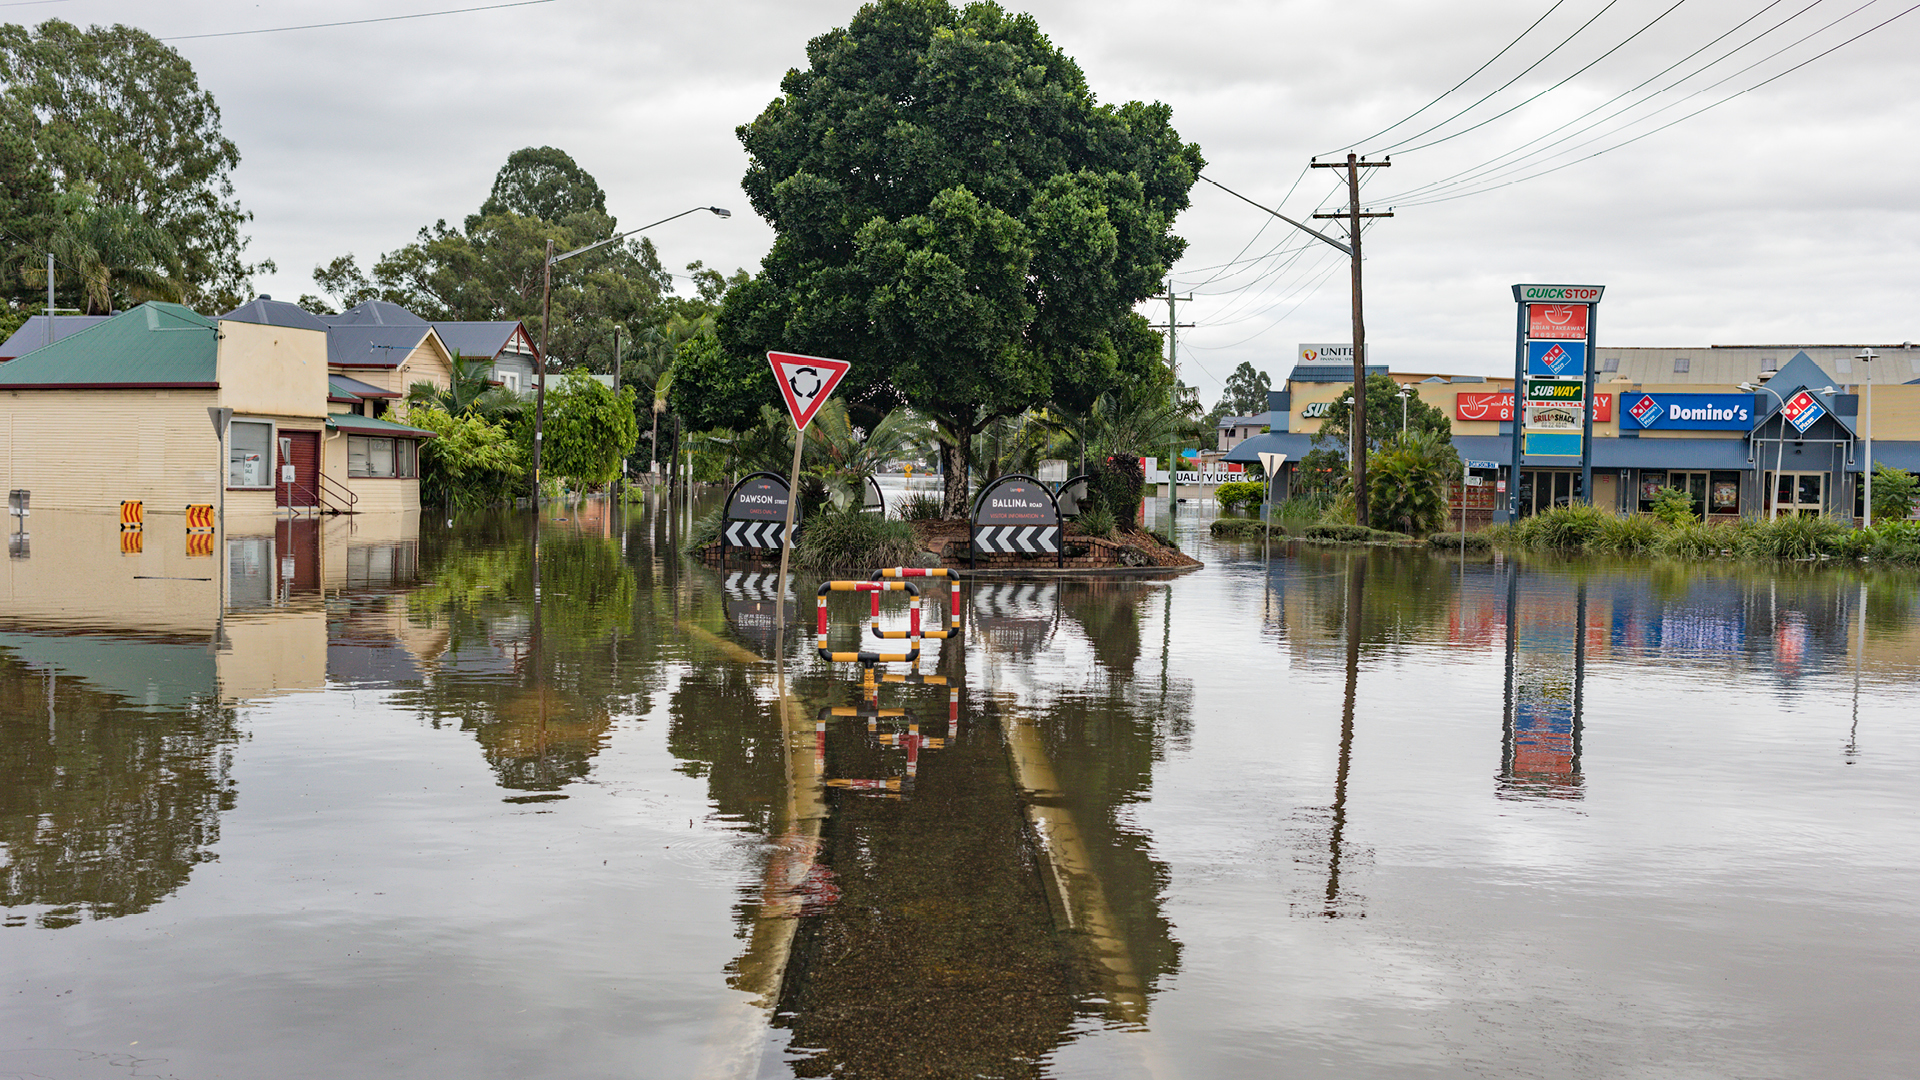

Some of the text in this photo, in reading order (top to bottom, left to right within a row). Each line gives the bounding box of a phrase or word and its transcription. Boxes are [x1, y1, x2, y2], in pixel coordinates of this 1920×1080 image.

[1320, 347, 1354, 356] UNITE
[1530, 385, 1581, 397] SUBWAY
[1669, 403, 1748, 421] Domino's
[1794, 405, 1818, 426] Domino's
[1533, 414, 1577, 424] GRILL SHACK
[1798, 416, 1815, 430] Pizza
[1168, 473, 1213, 482] UALITY
[740, 494, 773, 504] DAWSON
[992, 498, 1027, 508] BALLINA
